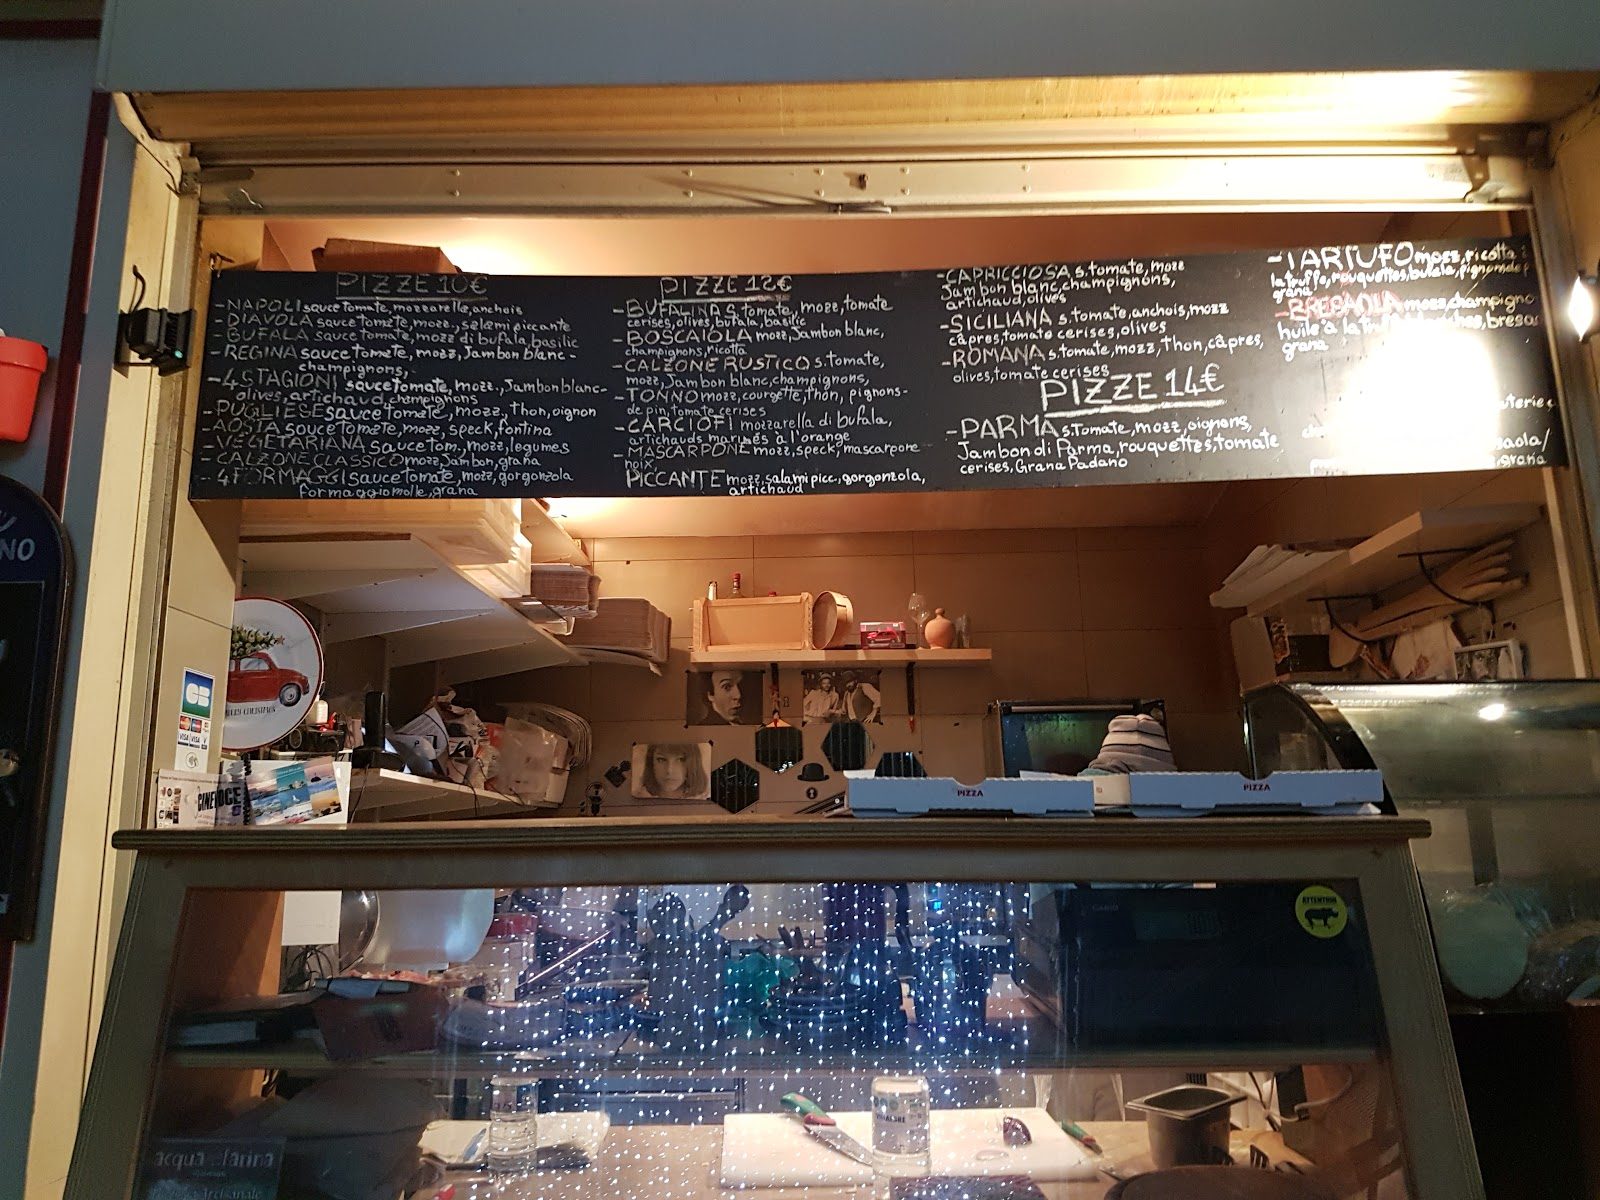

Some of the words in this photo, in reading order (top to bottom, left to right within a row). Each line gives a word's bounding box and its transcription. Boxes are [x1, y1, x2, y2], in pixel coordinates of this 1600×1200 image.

[460, 331, 474, 345] di
[300, 348, 352, 360] sauce
[345, 381, 392, 393] sauce
[1040, 372, 1158, 411] PIZZE
[1165, 363, 1225, 397] 14€
[324, 406, 382, 422] sauce
[552, 406, 597, 422] oignon
[627, 404, 643, 416] de
[719, 406, 767, 417] cerises
[819, 411, 832, 427] di
[369, 440, 425, 455] sauce
[510, 436, 570, 457] legumes
[1034, 438, 1051, 457] di
[1214, 427, 1280, 450] tomate
[498, 455, 541, 471] grana
[1015, 458, 1066, 474] Grana
[1068, 455, 1129, 470] Padano
[347, 471, 401, 486] sauce
[498, 467, 574, 486] gorgonzola
[626, 468, 726, 490] PICCANTE
[765, 468, 808, 486] salami
[729, 483, 804, 496] artichaud
[957, 789, 984, 797] PIZZA
[1243, 783, 1271, 791] PIZZA
